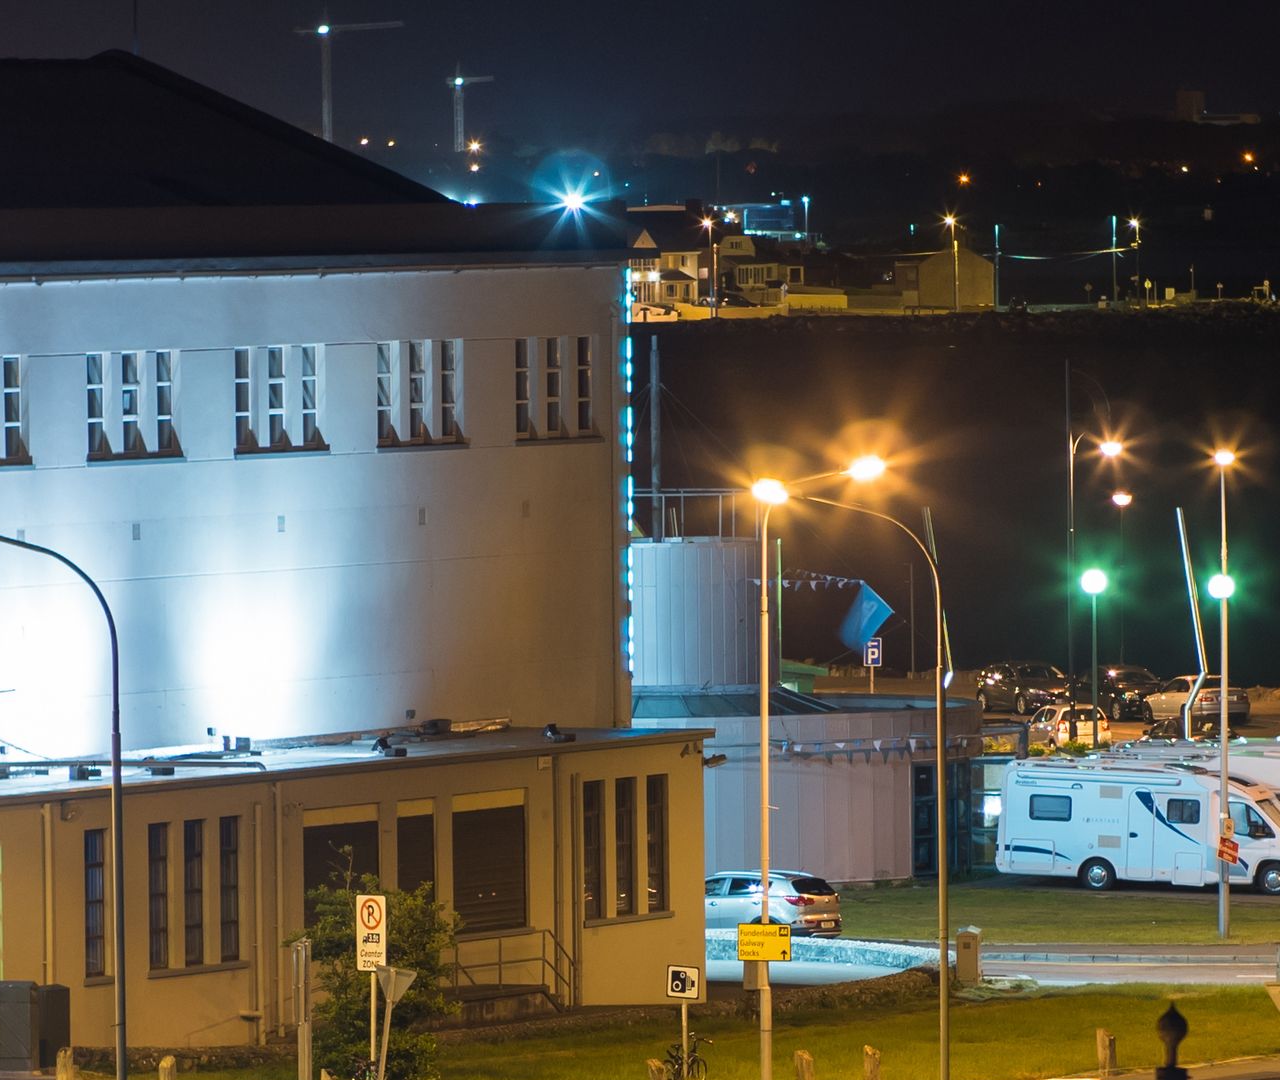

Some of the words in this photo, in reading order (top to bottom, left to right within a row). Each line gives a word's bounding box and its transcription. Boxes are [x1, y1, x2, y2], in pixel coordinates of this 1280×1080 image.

[867, 647, 879, 665] P
[740, 929, 777, 937] Funderland
[740, 940, 764, 949] Galway
[740, 949, 759, 957] Docks
